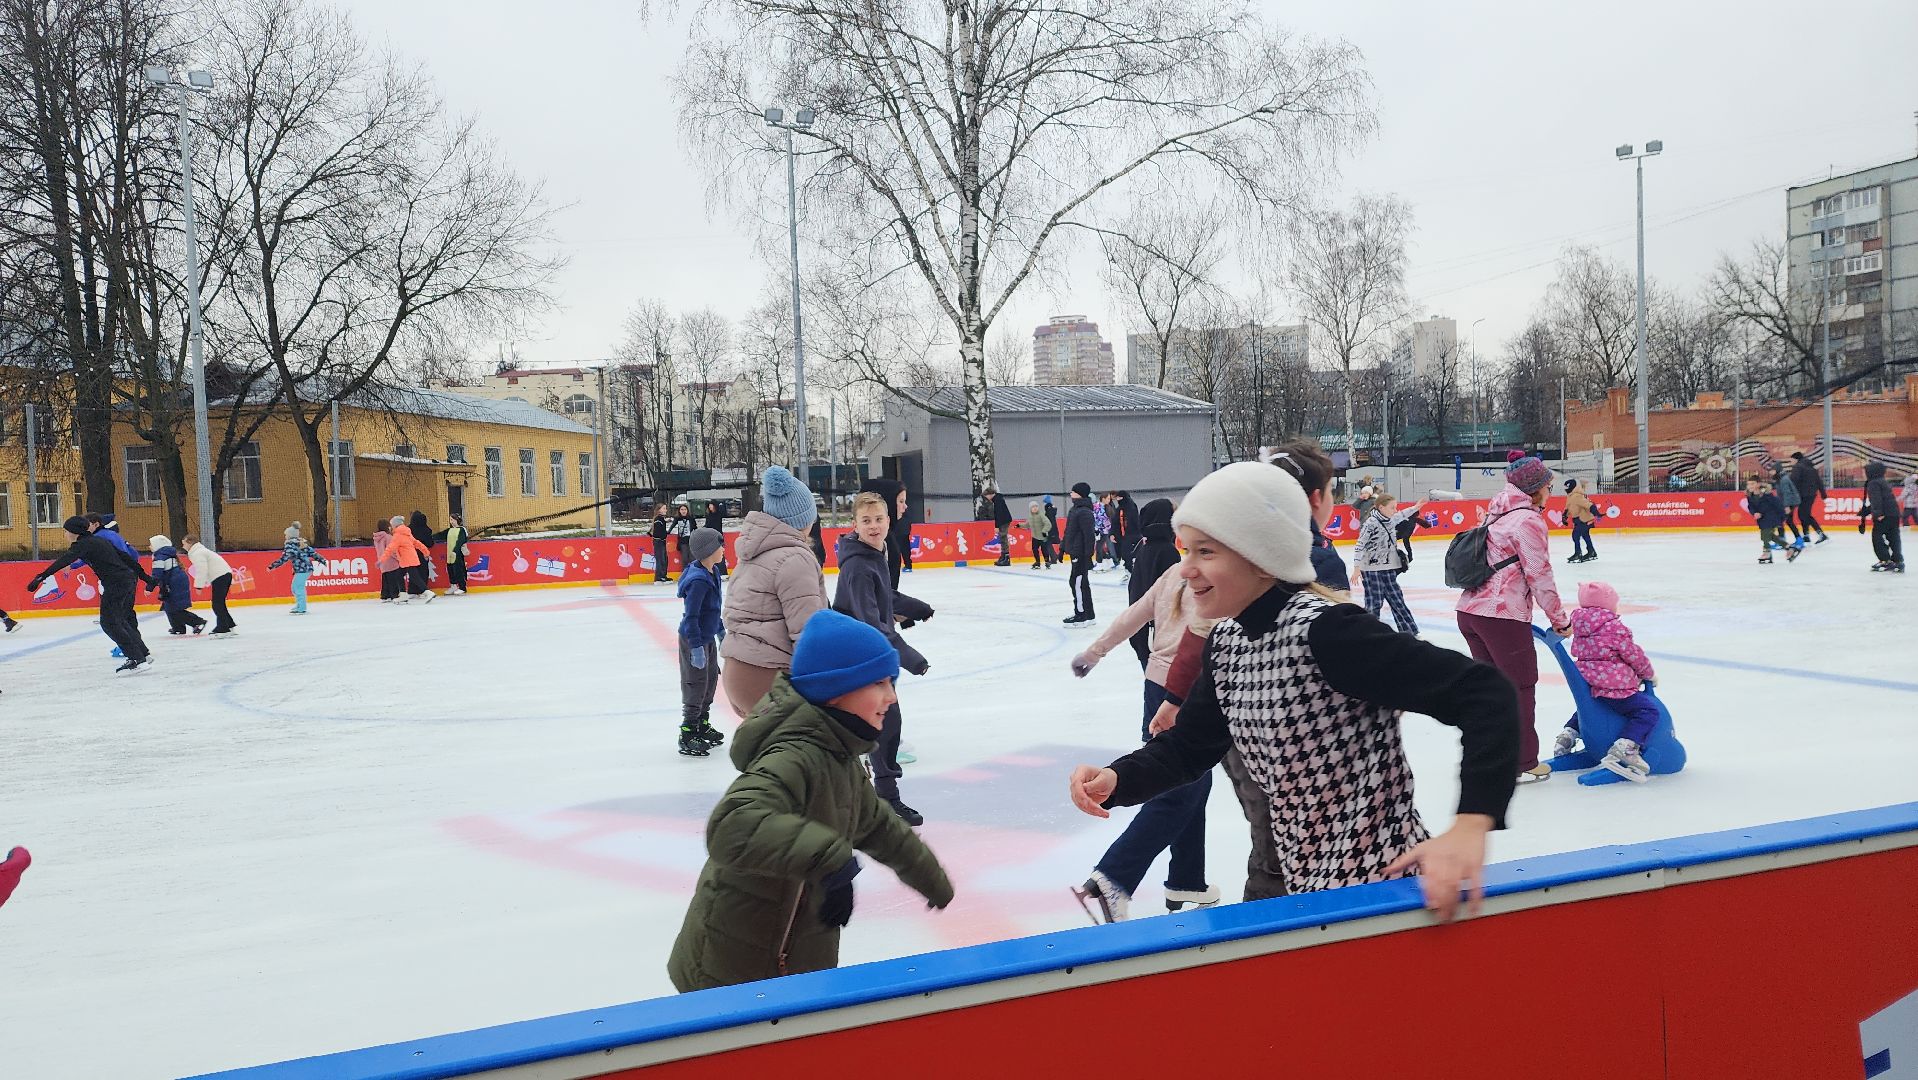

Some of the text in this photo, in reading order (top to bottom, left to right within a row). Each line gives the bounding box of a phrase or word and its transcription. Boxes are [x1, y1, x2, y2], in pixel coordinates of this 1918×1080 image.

[1647, 501, 1690, 509] КАТАЙТЕСЬ
[311, 557, 369, 576] ИМА
[305, 577, 369, 587] ПОДМОСКОВЬЕ
